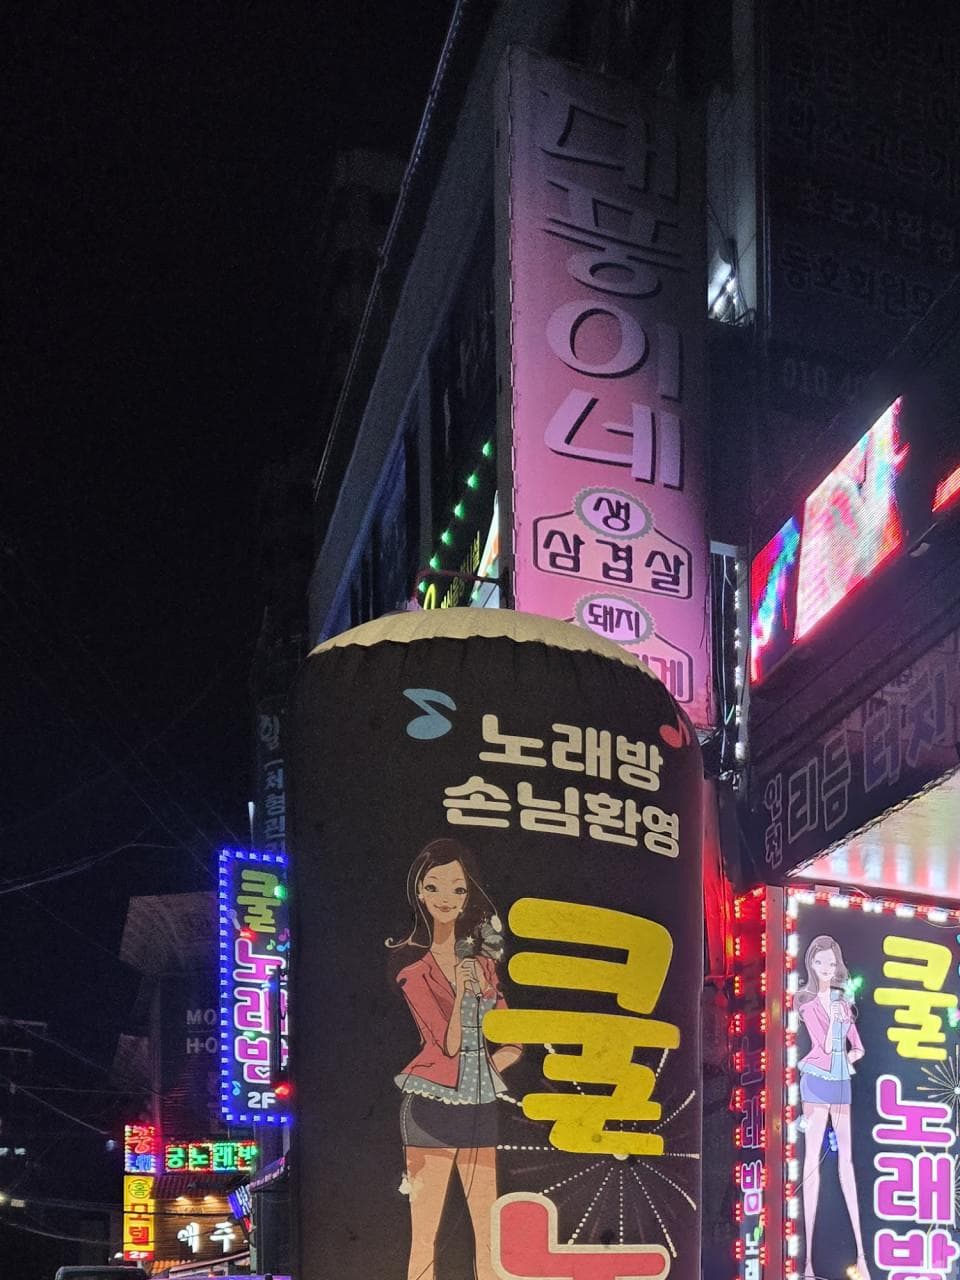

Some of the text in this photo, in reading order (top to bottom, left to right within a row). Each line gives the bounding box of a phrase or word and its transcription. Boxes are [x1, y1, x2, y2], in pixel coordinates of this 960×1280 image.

[593, 497, 631, 531] 생
[542, 529, 686, 593] 삼겹살
[588, 603, 640, 638] 돼지
[478, 713, 664, 793] 노래방
[442, 775, 680, 858] 손님환영
[482, 896, 681, 1157] 쿨
[873, 935, 959, 1061] 쿨
[247, 1090, 277, 1110] 2F
